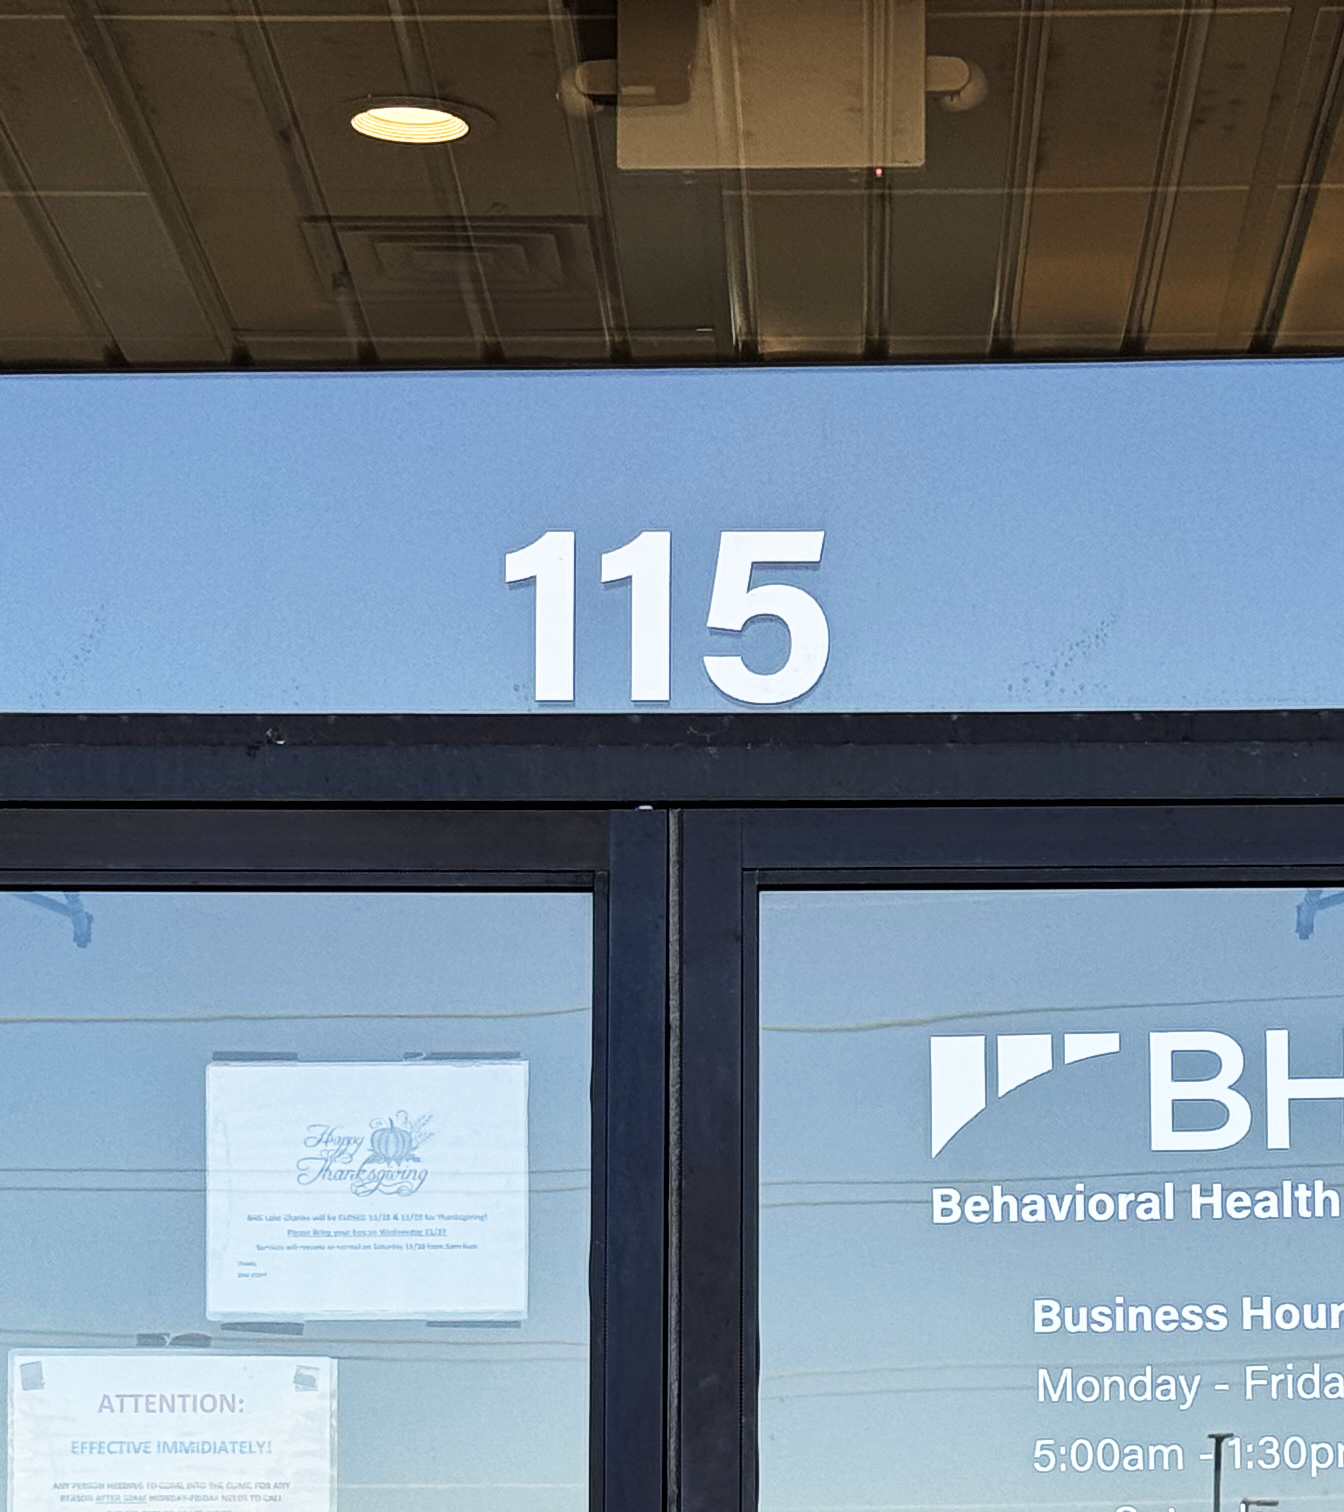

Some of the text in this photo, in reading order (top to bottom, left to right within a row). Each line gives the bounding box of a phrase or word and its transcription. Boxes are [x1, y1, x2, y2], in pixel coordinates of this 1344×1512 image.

[505, 531, 830, 704] 115
[303, 1123, 364, 1164] Happy
[296, 1153, 429, 1197] Thanksgiving
[931, 1182, 1174, 1224] Behavioral
[1191, 1180, 1340, 1221] Health
[1032, 1296, 1229, 1334] Business
[97, 1393, 245, 1415] ATTENTION:
[1036, 1364, 1202, 1411] Monday
[1213, 1383, 1230, 1391] -
[70, 1440, 152, 1455] EFFECTIVE
[1032, 1437, 1185, 1473] 5:00am
